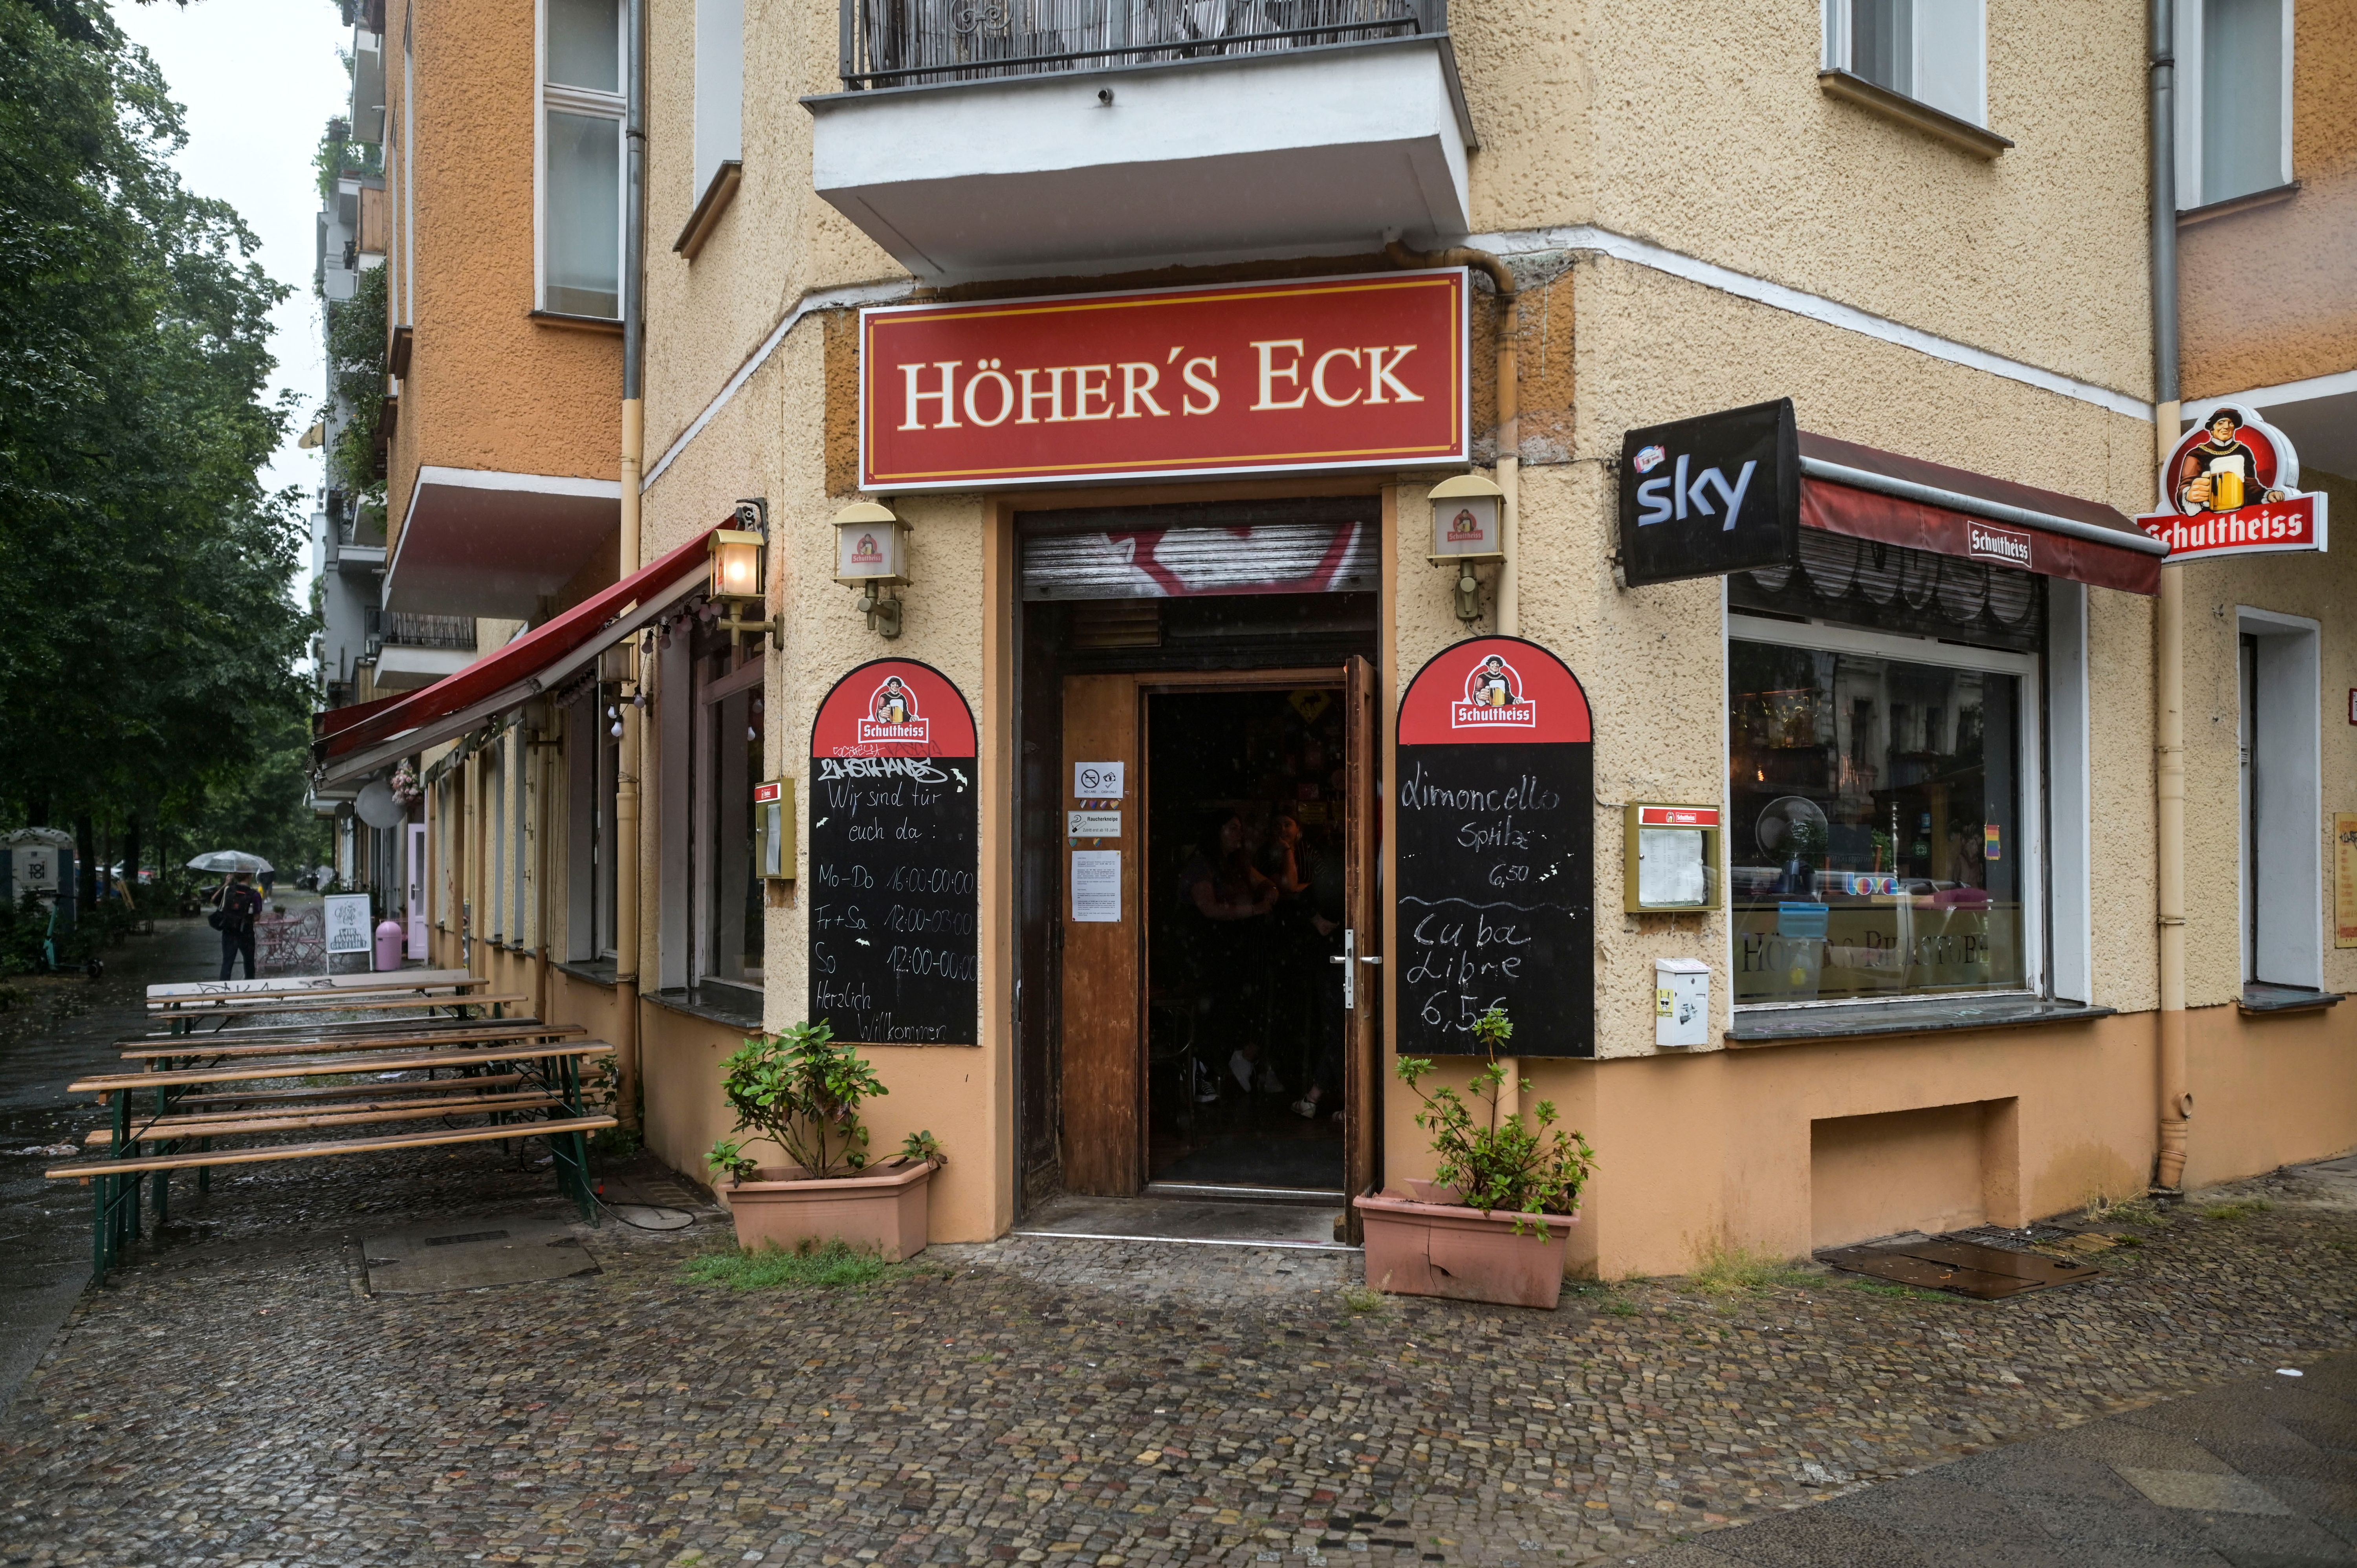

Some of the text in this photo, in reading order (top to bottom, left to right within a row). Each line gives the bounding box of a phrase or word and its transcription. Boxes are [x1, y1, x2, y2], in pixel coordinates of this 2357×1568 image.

[1250, 338, 1424, 411] ECK
[1637, 454, 1757, 531] sky
[1972, 529, 2028, 559] Schultheiss
[1458, 707, 1529, 722] Schultheiss
[863, 724, 924, 737] Schultheiss
[828, 778, 942, 808] Wir sind für
[849, 817, 884, 841] euch
[1489, 864, 1529, 888] 6,50
[1414, 913, 1531, 947] Cuba
[816, 942, 836, 973] So
[1407, 950, 1521, 984] Libre
[816, 980, 871, 1011] Herzlich
[858, 1012, 947, 1042] Willkommen
